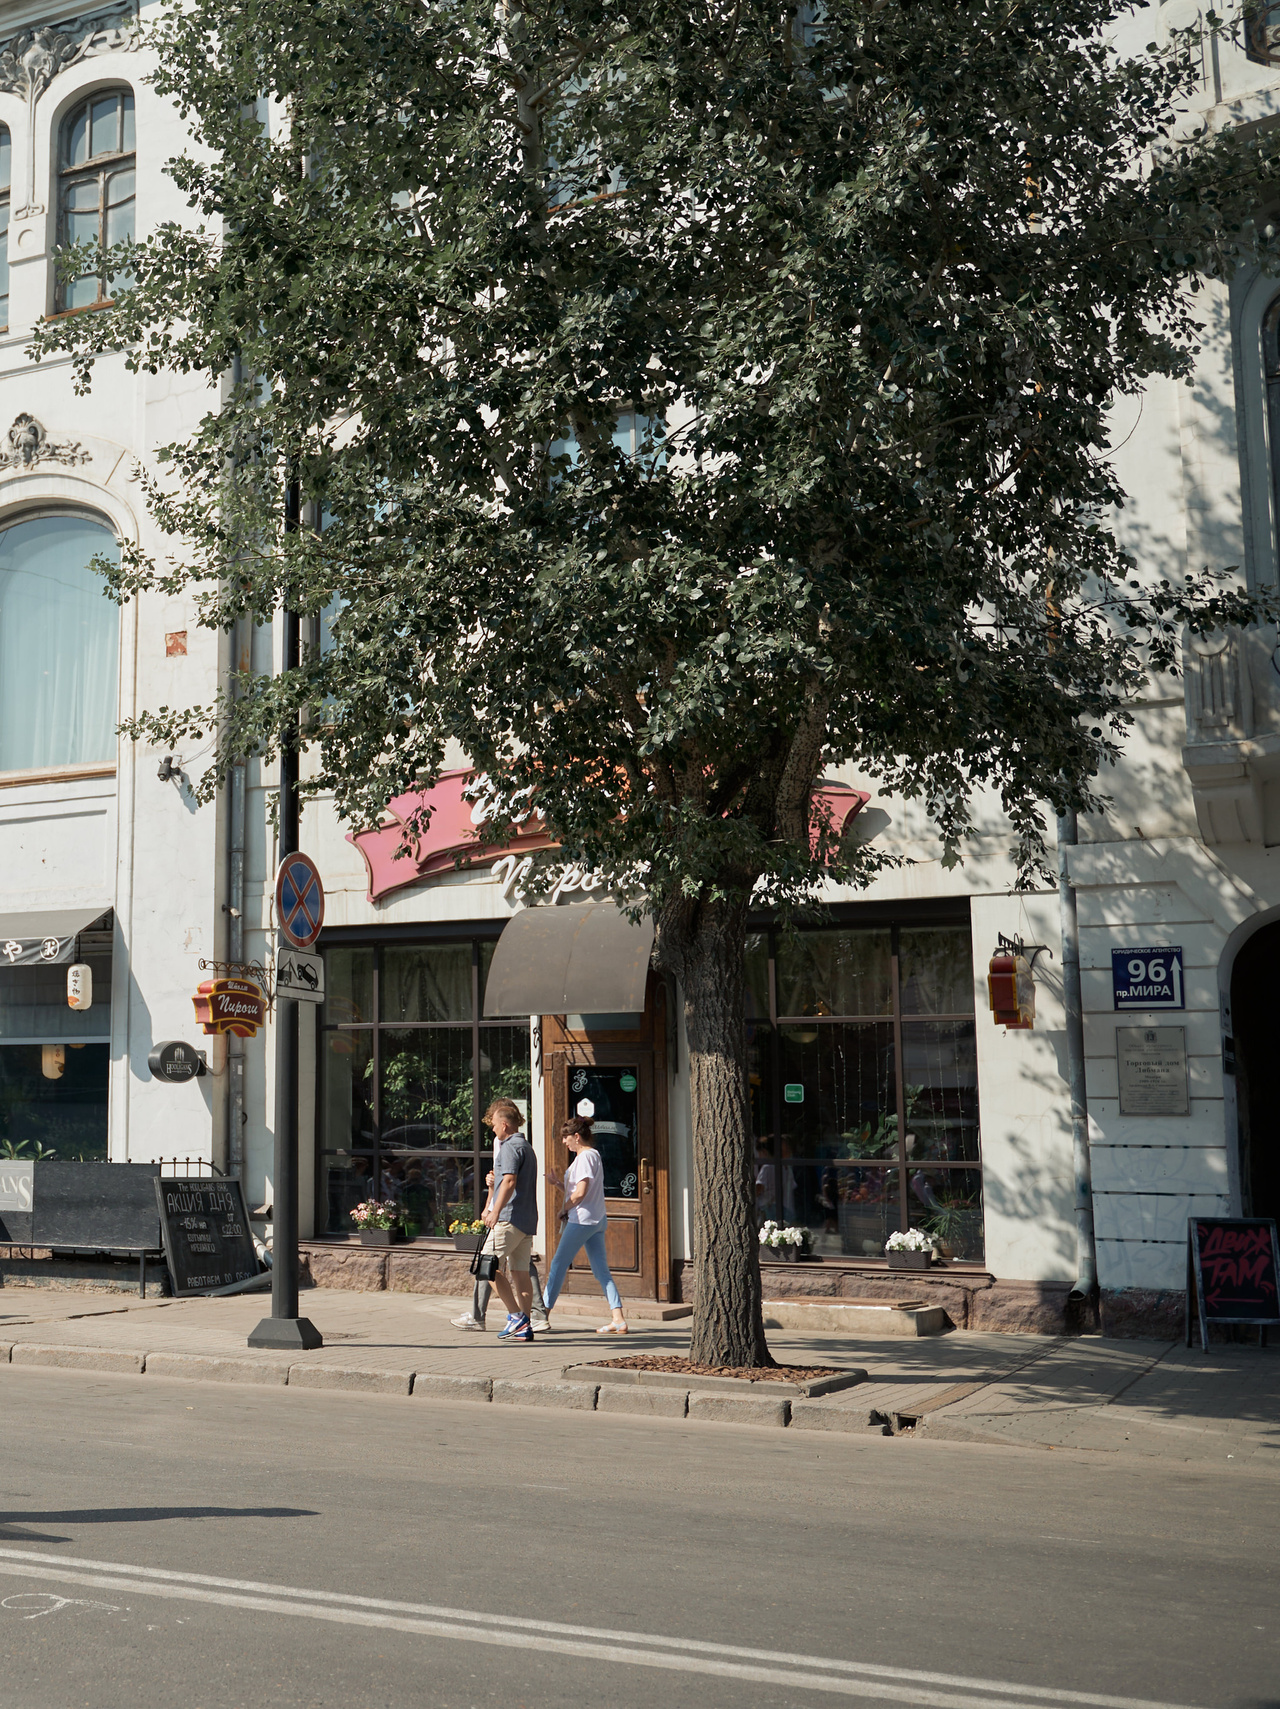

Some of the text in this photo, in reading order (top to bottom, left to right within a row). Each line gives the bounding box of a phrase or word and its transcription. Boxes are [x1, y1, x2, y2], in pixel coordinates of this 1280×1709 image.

[1127, 958, 1167, 983] 96
[217, 994, 259, 1017] Пироги
[167, 1192, 204, 1213] АКЦИЯ
[1201, 1254, 1271, 1289] ТАМ
